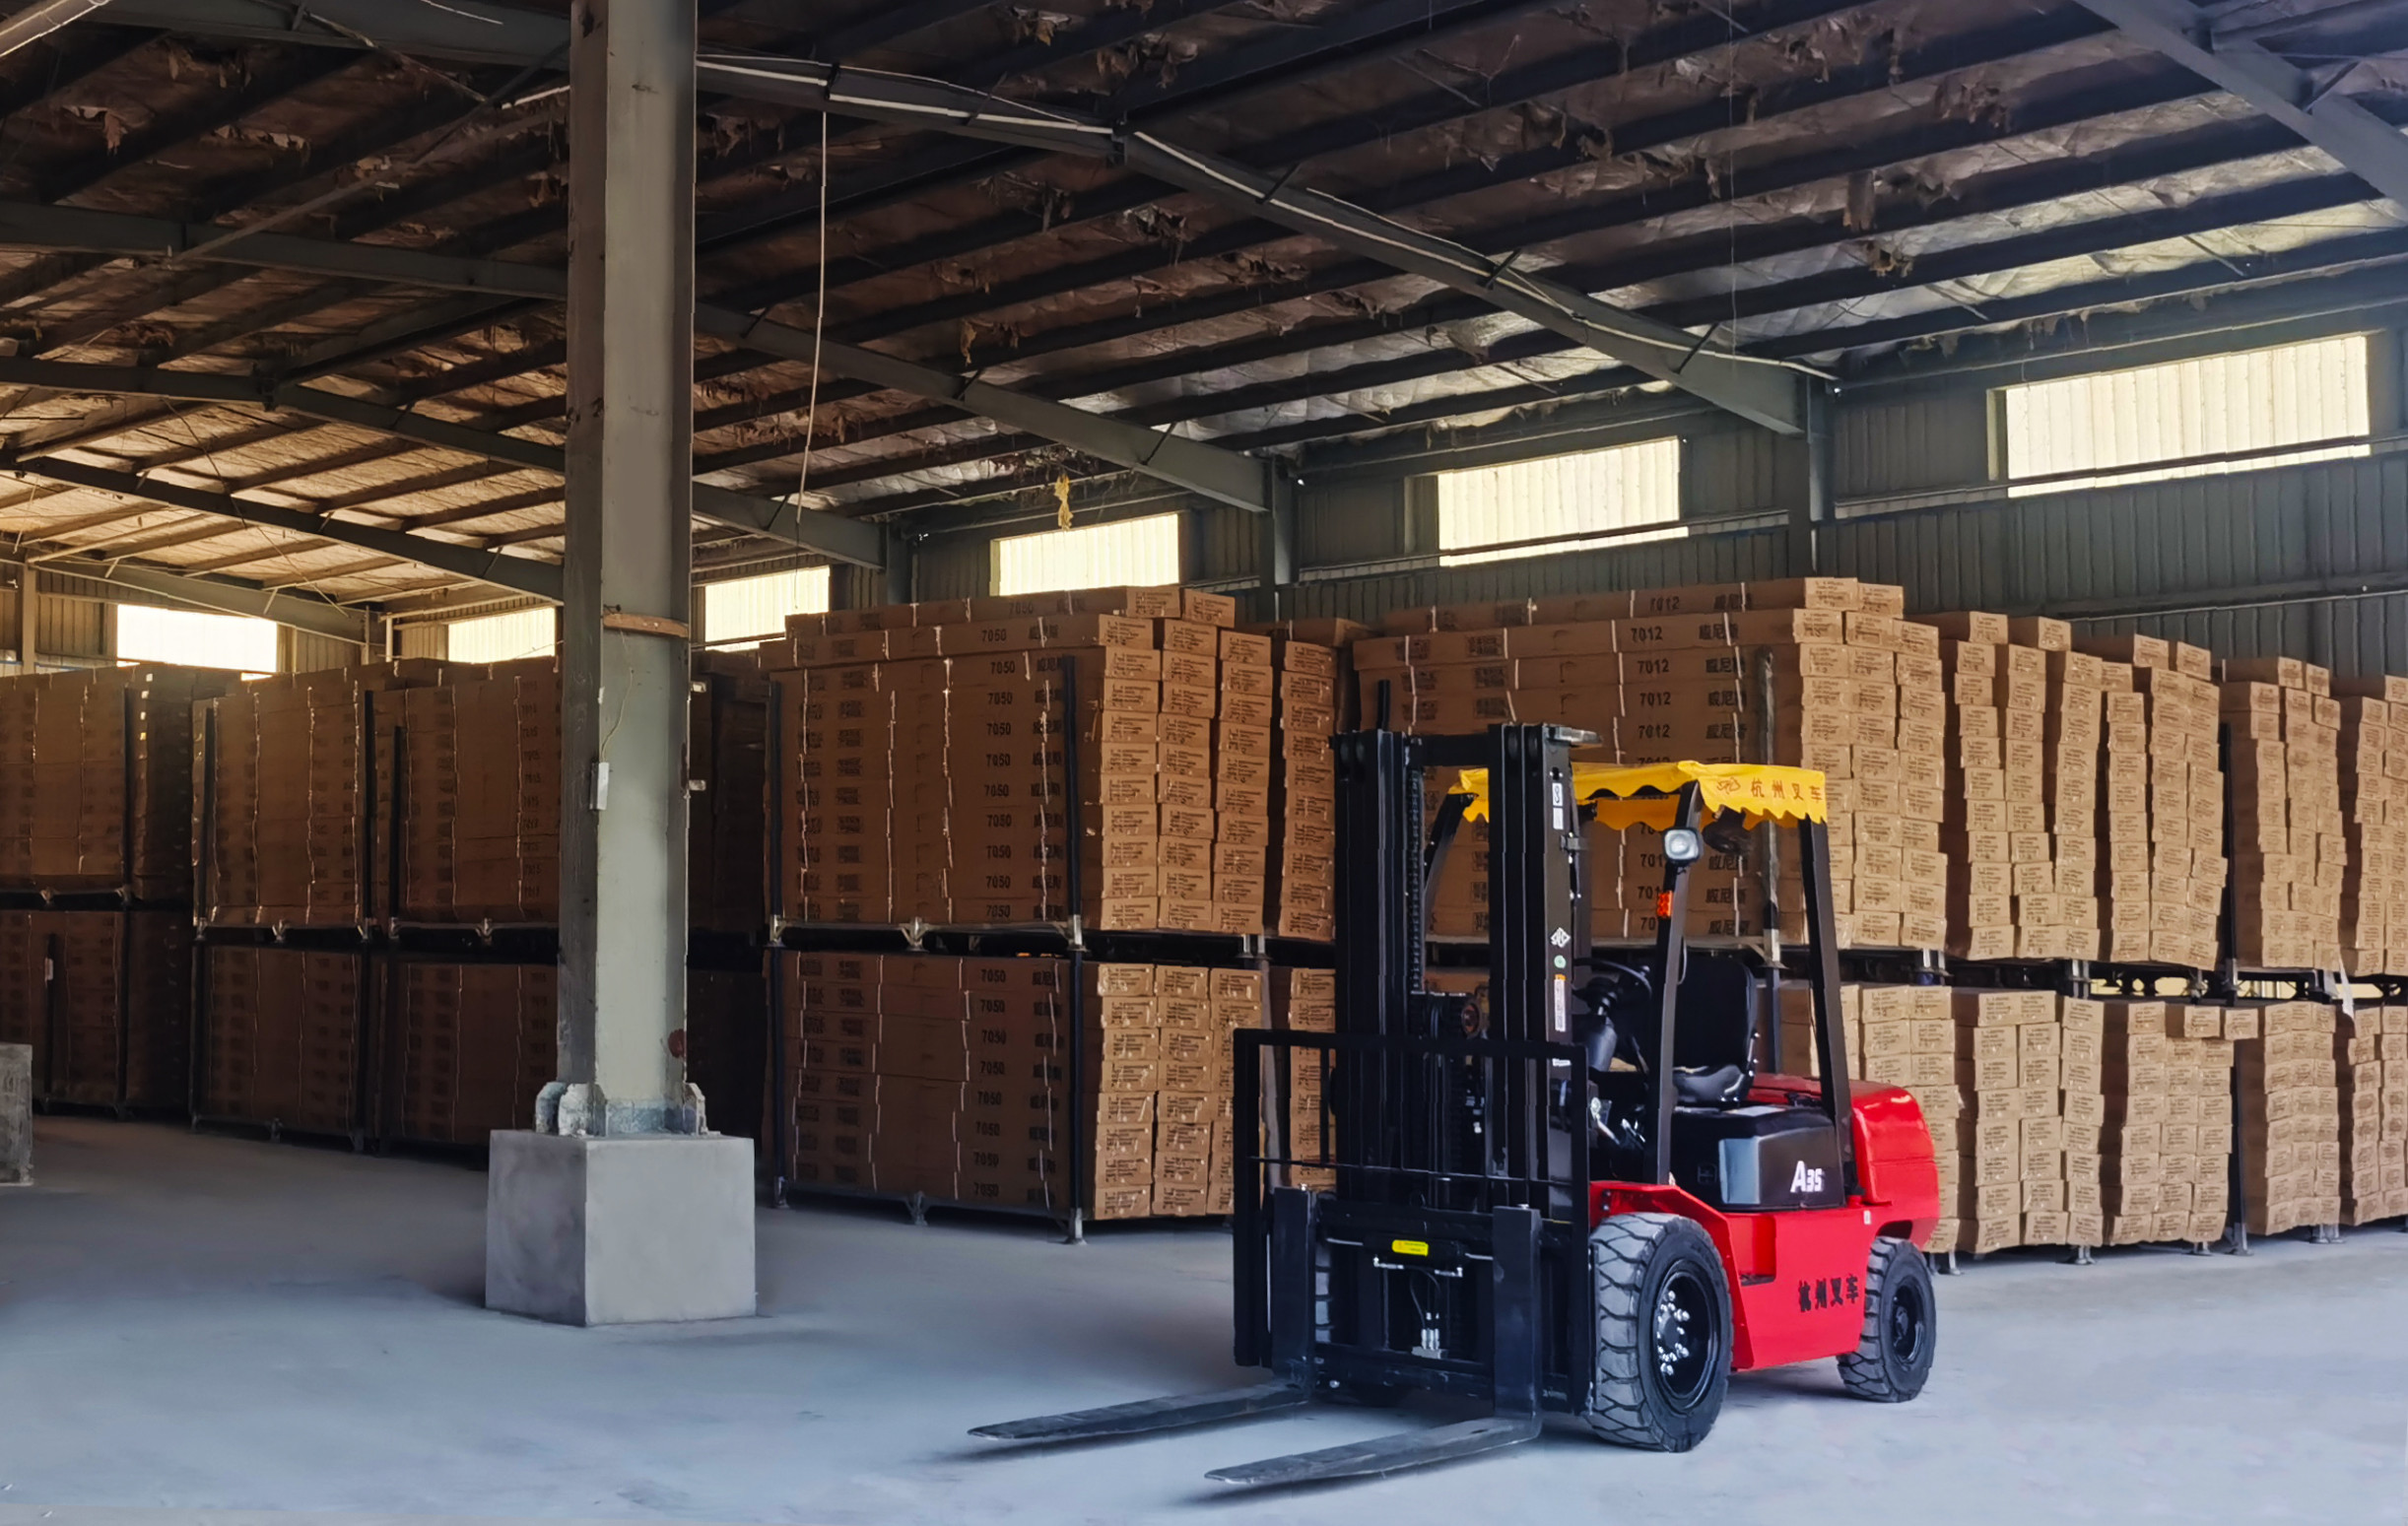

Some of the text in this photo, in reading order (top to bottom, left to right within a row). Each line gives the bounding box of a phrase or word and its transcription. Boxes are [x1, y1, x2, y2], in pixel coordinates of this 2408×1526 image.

[1650, 596, 1680, 611] 7012
[1632, 627, 1662, 642] 7012
[990, 661, 1015, 674] 7050
[1638, 659, 1669, 674] 7012
[988, 693, 1013, 704] 7050
[1640, 692, 1671, 707] 7012
[986, 723, 1011, 735] 7050
[1639, 725, 1670, 739] 7012
[984, 784, 1009, 796] 7050
[1751, 778, 1823, 802] 杭州叉车
[987, 815, 1011, 828] 7050
[987, 845, 1011, 858] 7050
[1640, 853, 1662, 867] 701
[986, 876, 1010, 889] 7050
[980, 969, 1006, 983] 7050
[980, 999, 1005, 1013] 7050
[982, 1029, 1006, 1044] 7050
[980, 1061, 1005, 1075] 7050
[977, 1092, 1001, 1105] 7050
[975, 1121, 1000, 1136] 7050
[973, 1153, 999, 1167] 7050
[1798, 1273, 1858, 1312] 杭州叉车
